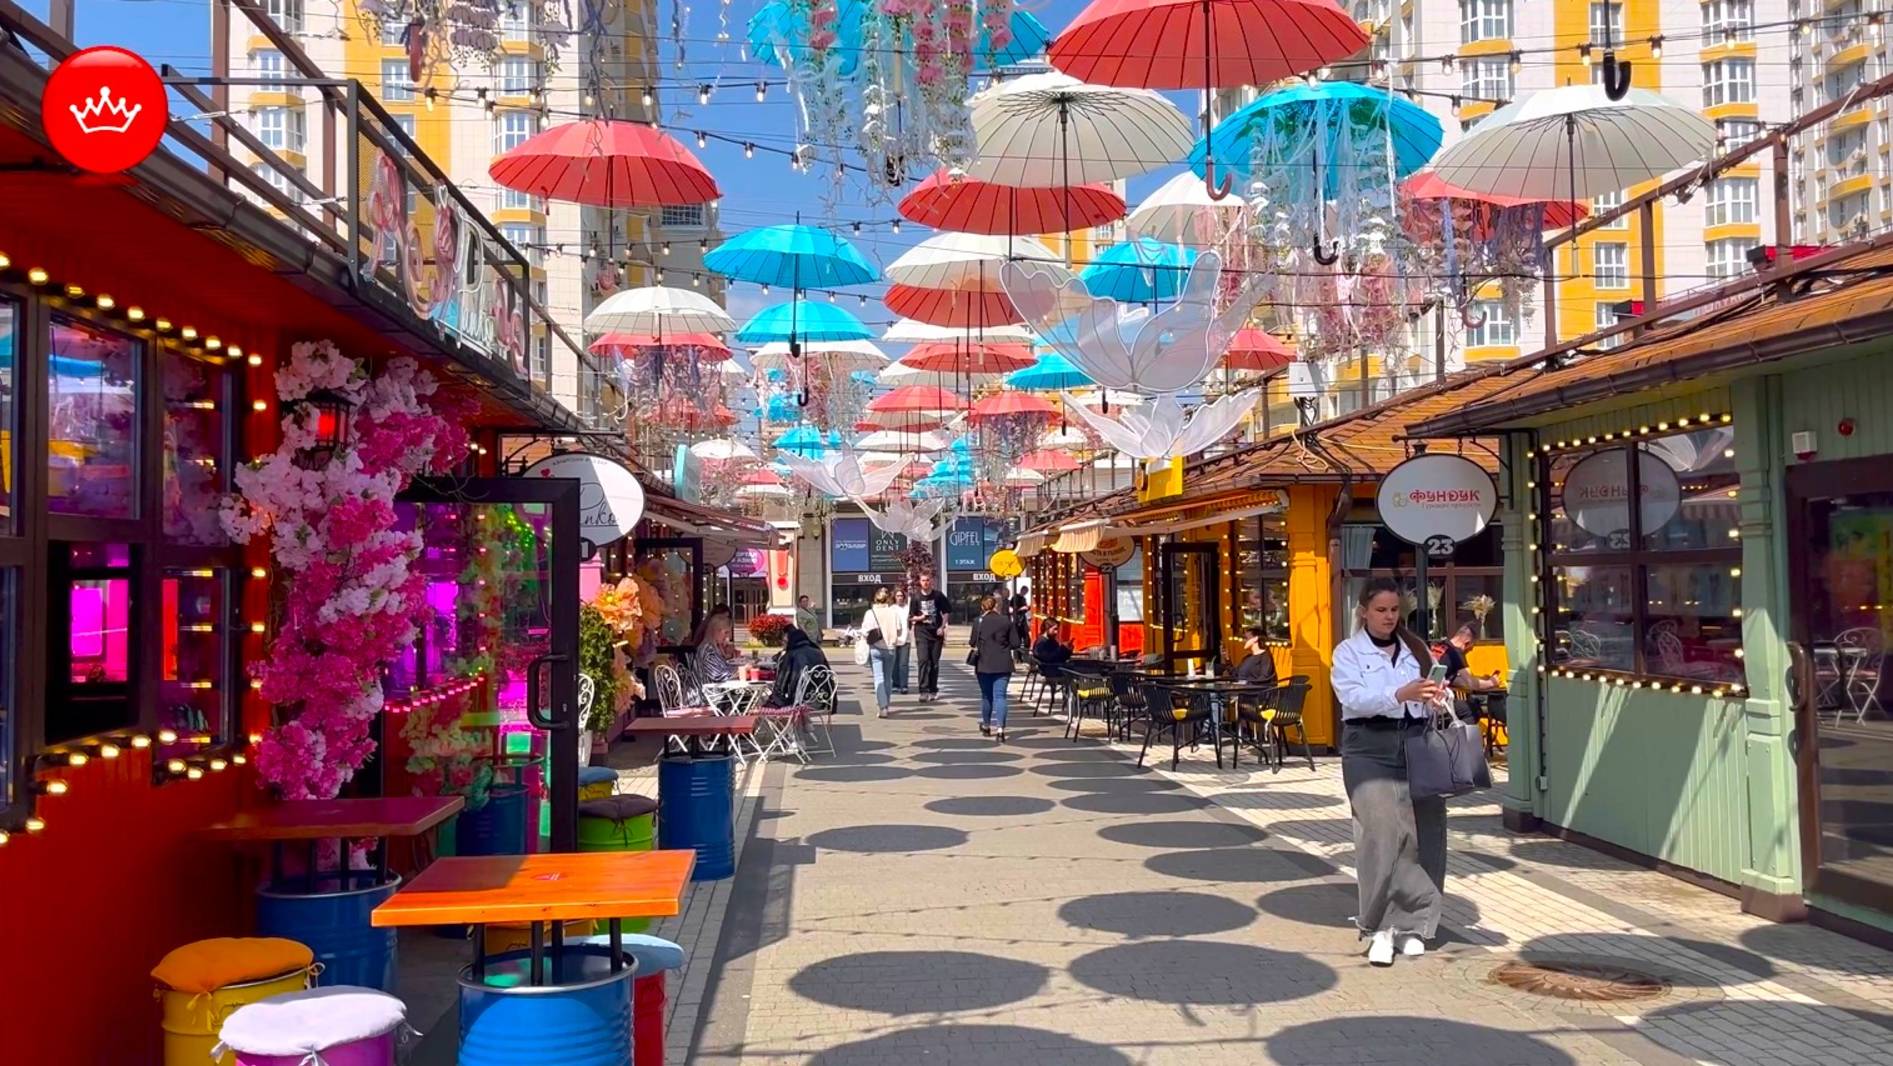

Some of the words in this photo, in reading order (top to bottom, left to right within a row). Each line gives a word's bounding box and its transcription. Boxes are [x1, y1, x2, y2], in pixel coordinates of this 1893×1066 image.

[950, 531, 980, 546] GIPFEL
[1427, 538, 1454, 555] 23
[858, 574, 882, 583] ВХОД
[973, 573, 997, 583] ВХОД
